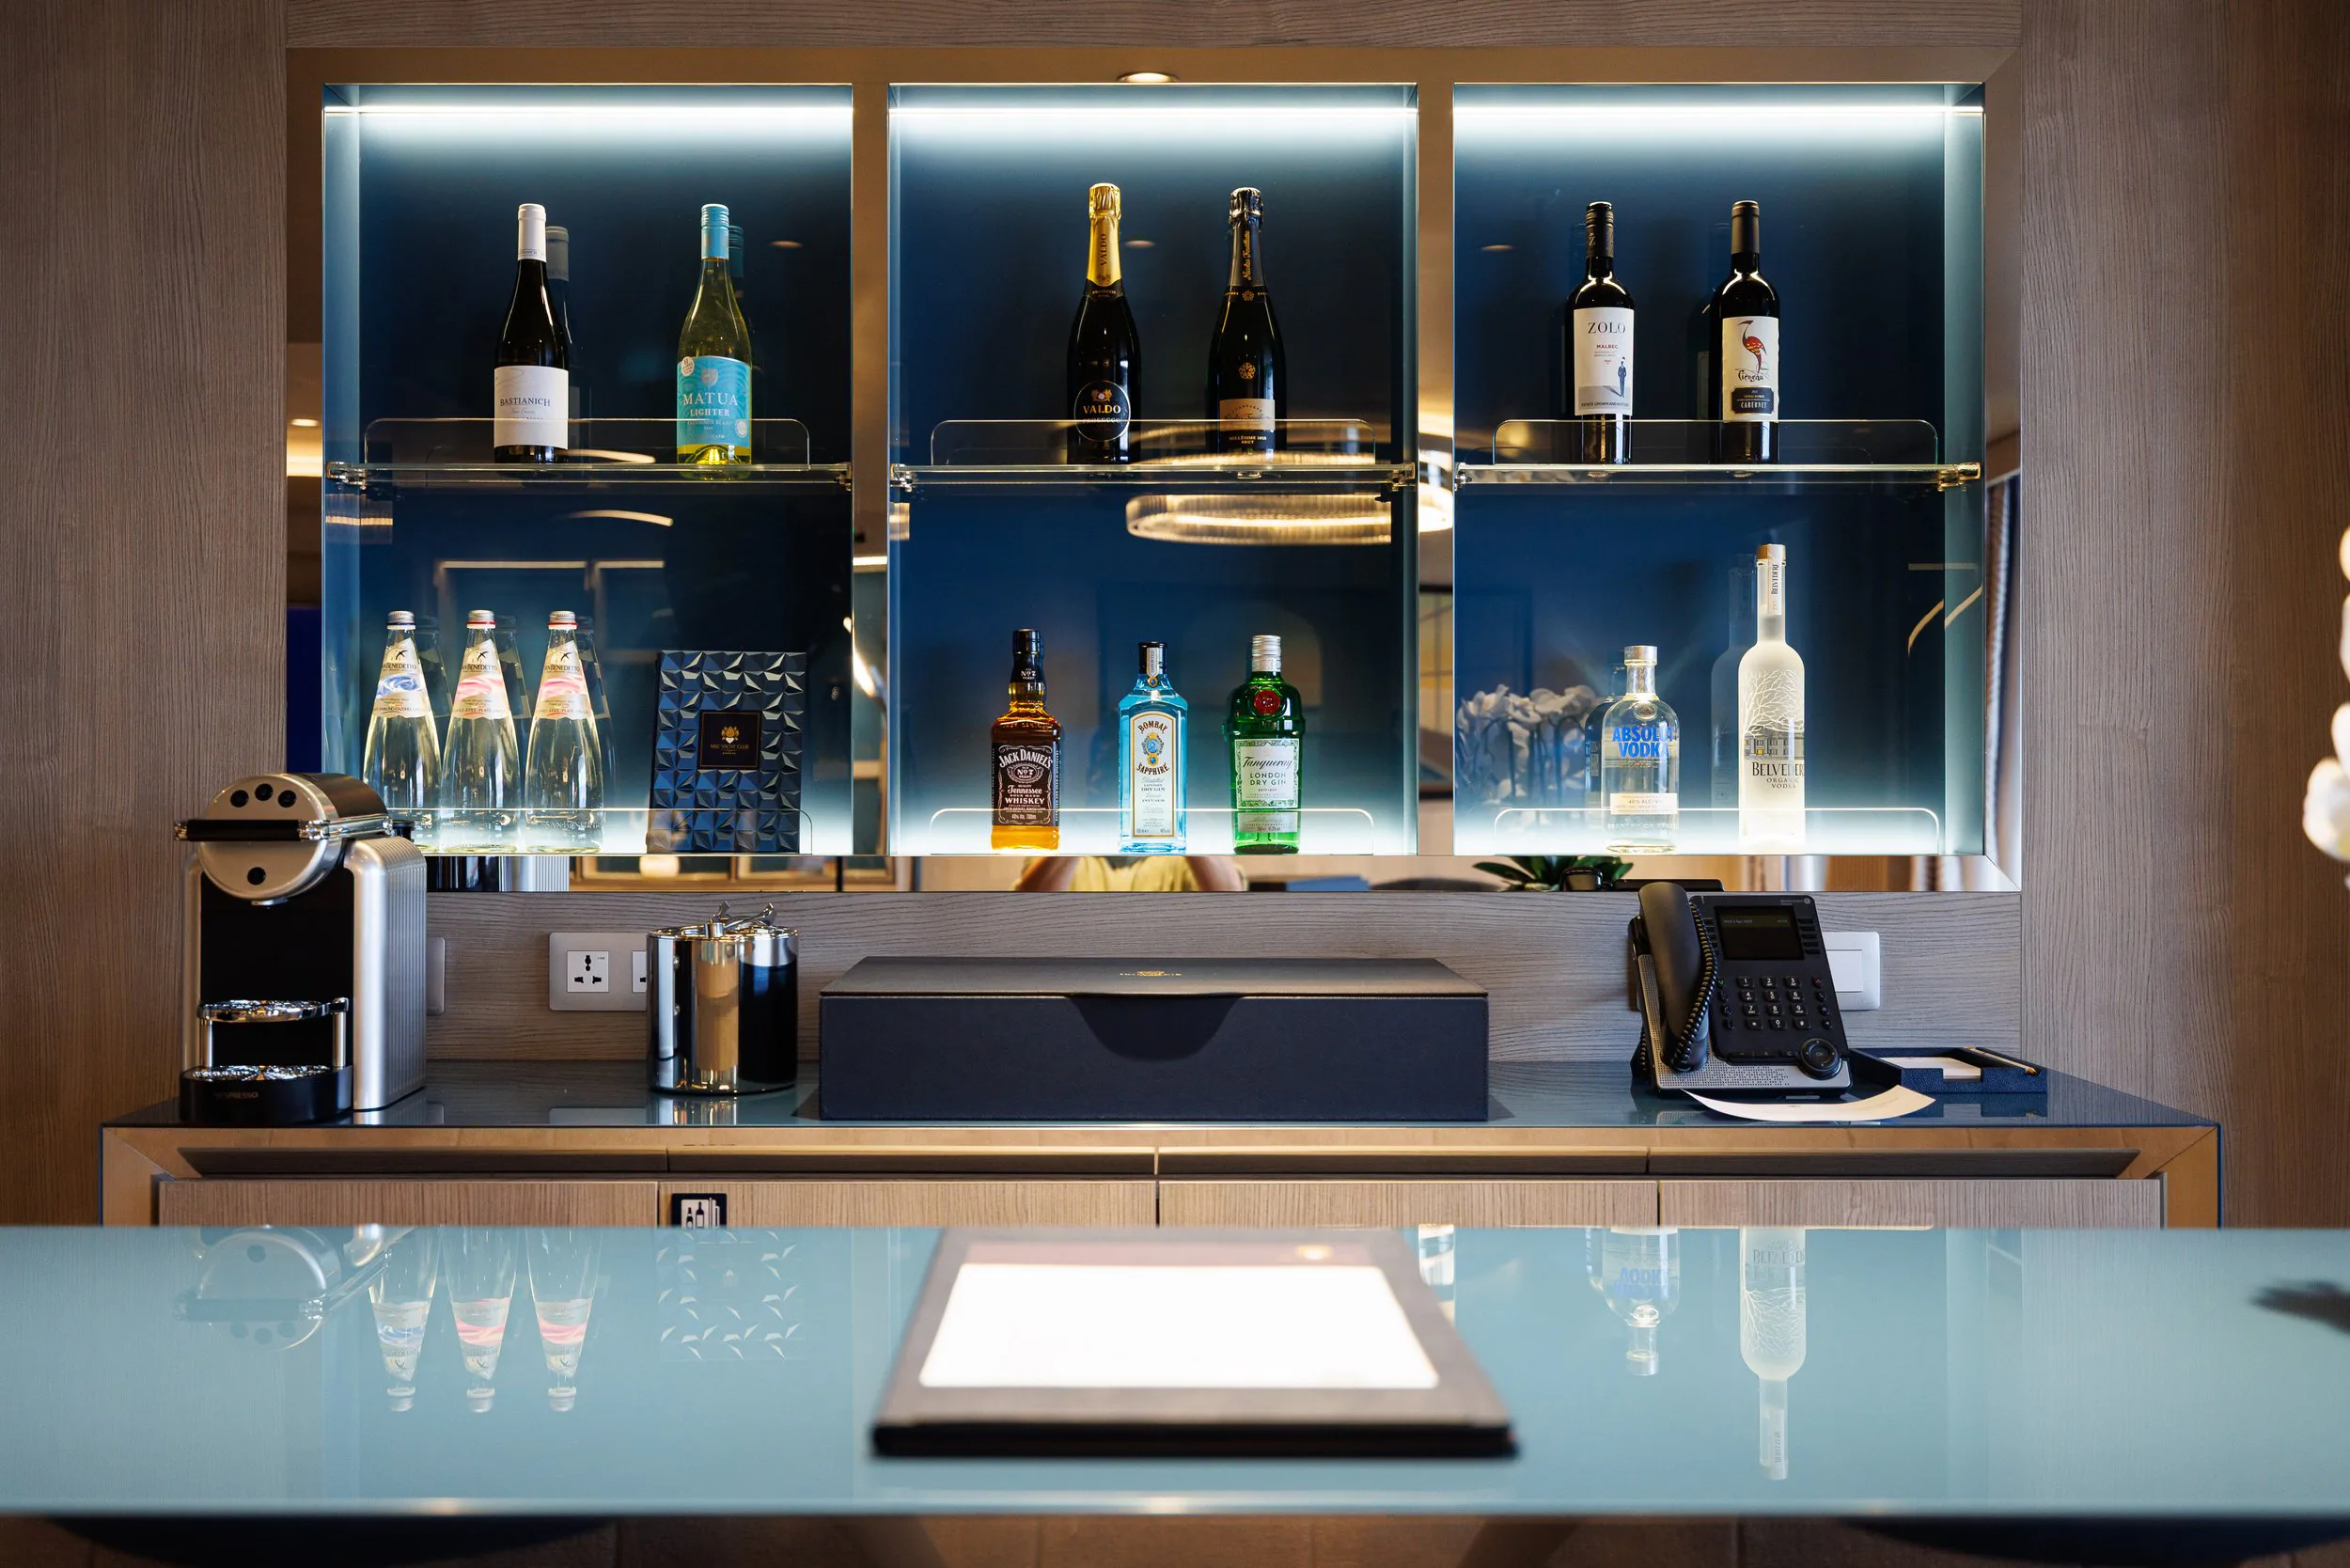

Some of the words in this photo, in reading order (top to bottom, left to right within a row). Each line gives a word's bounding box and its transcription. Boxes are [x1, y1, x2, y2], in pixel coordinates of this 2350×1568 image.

[1588, 321, 1626, 334] ZOLO
[500, 398, 551, 406] BASTIANICH
[682, 392, 738, 406] MATUA
[690, 408, 730, 416] LIGHTER
[1083, 404, 1121, 414] VALDO
[1137, 720, 1168, 733] BOMBAY
[998, 751, 1021, 768] JACK
[1019, 748, 1054, 770] DANIEL'S
[1242, 756, 1293, 770] Tanqueray
[1136, 762, 1171, 776] SAPPHIRE
[1007, 784, 1043, 794] Tennessee
